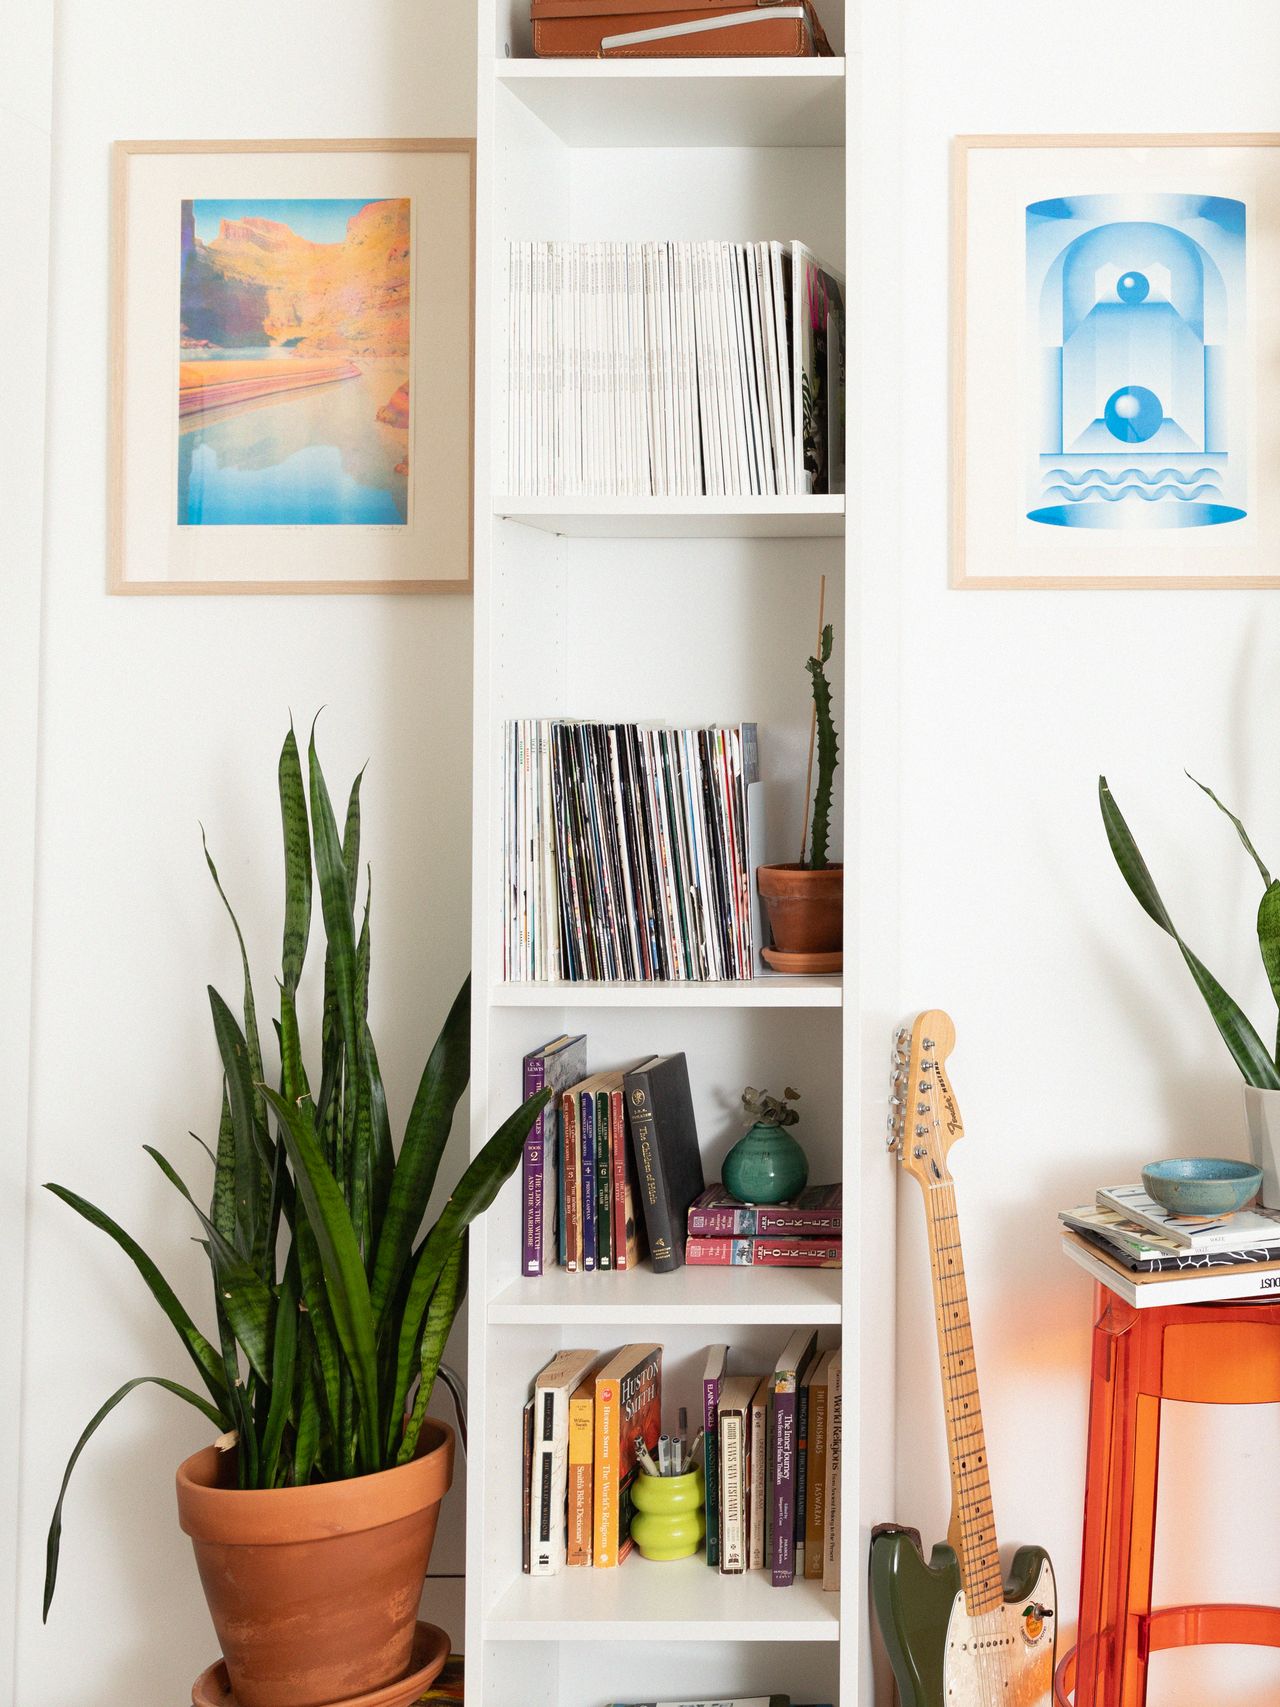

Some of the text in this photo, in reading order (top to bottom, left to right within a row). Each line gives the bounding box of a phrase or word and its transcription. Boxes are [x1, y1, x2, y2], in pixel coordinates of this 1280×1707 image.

[945, 1095, 963, 1136] Fender
[530, 1151, 539, 1162] 2
[527, 1175, 535, 1248] AND THE WARDROBE
[534, 1173, 543, 1250] THE LION, THE WITCH
[767, 1219, 831, 1227] TOLKIEN
[764, 1249, 826, 1257] TOLKIEN
[1259, 1277, 1280, 1290] DUST
[622, 1359, 659, 1405] HUSTON
[625, 1383, 656, 1422] SMITH
[776, 1409, 784, 1422] Views
[776, 1445, 784, 1462] Hindu
[782, 1414, 793, 1480] The Inner Journey
[575, 1466, 585, 1544] Smith's Bible Dictionary
[814, 1483, 823, 1527] EASWARAN
